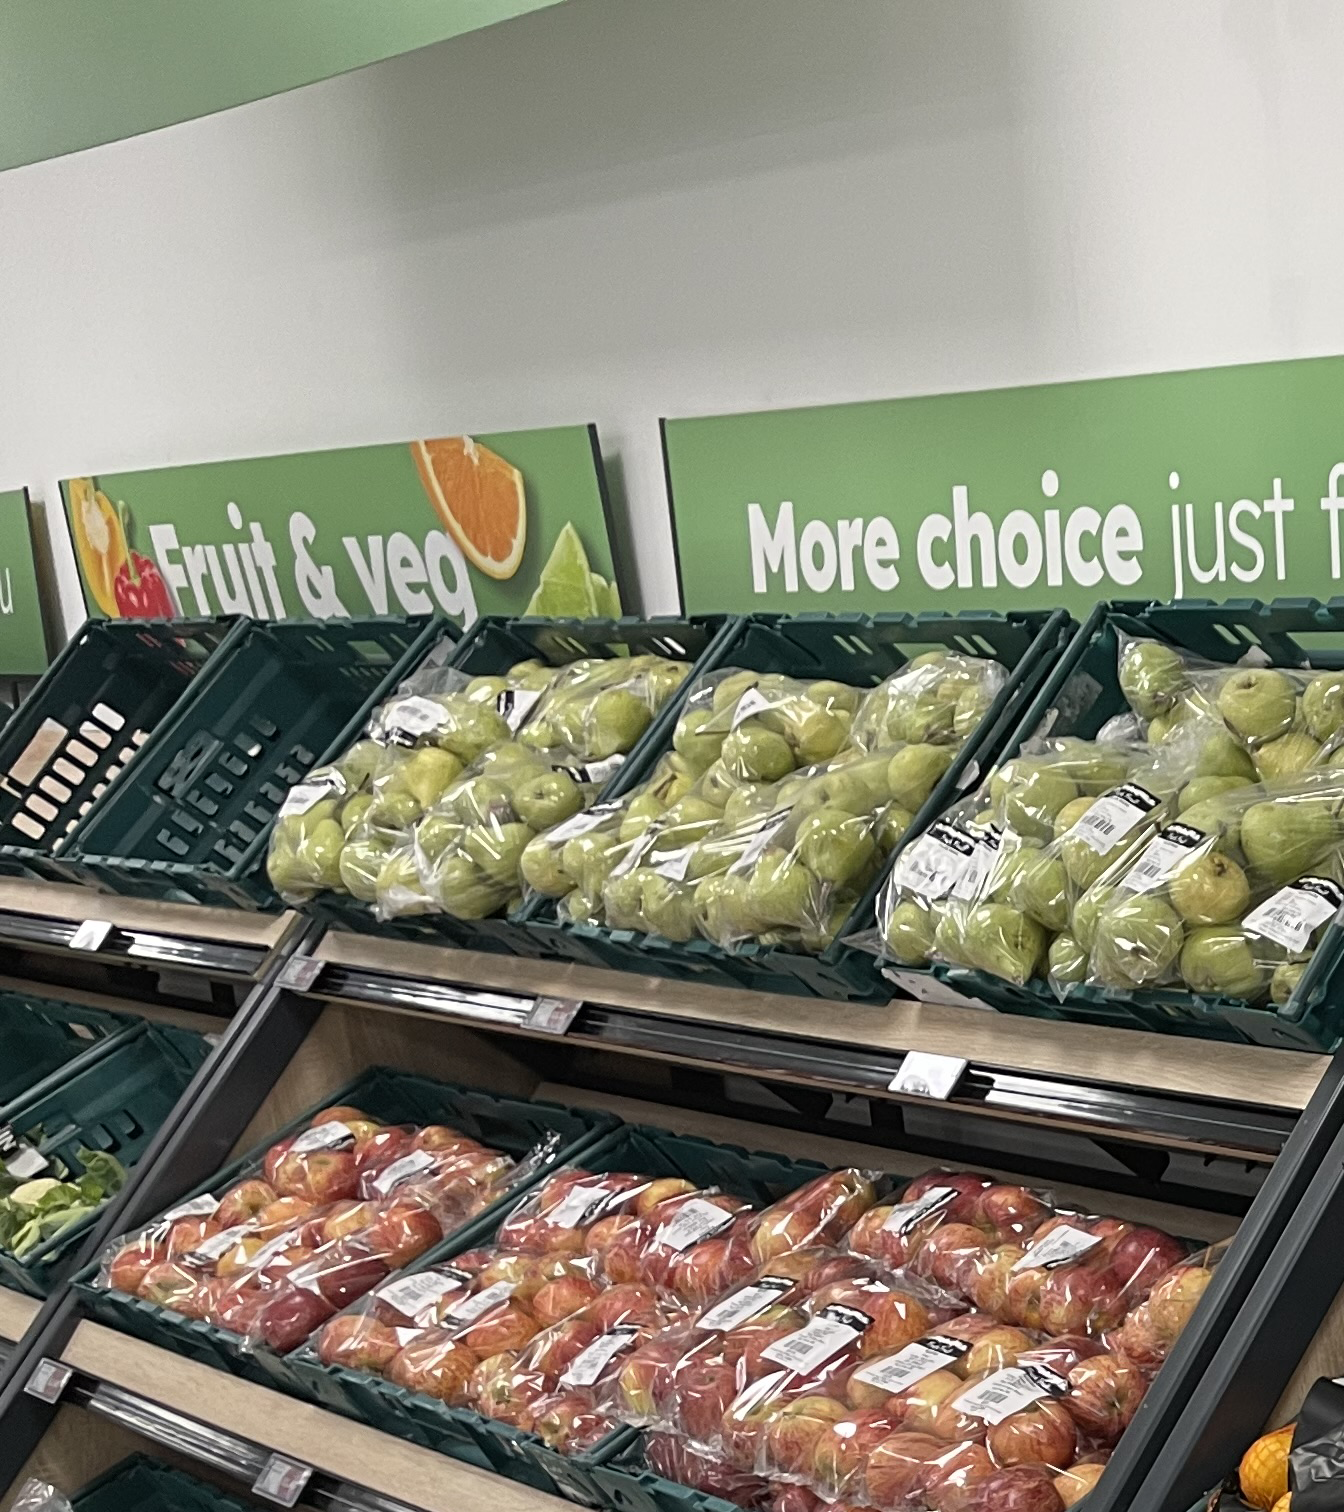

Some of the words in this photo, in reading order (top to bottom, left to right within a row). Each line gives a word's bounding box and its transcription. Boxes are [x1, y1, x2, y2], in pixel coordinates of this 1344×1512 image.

[149, 502, 287, 620] Fruit
[289, 511, 350, 620] &
[343, 529, 478, 634] veg
[747, 501, 900, 593] More
[917, 469, 1144, 590] choice
[1168, 471, 1294, 599] just
